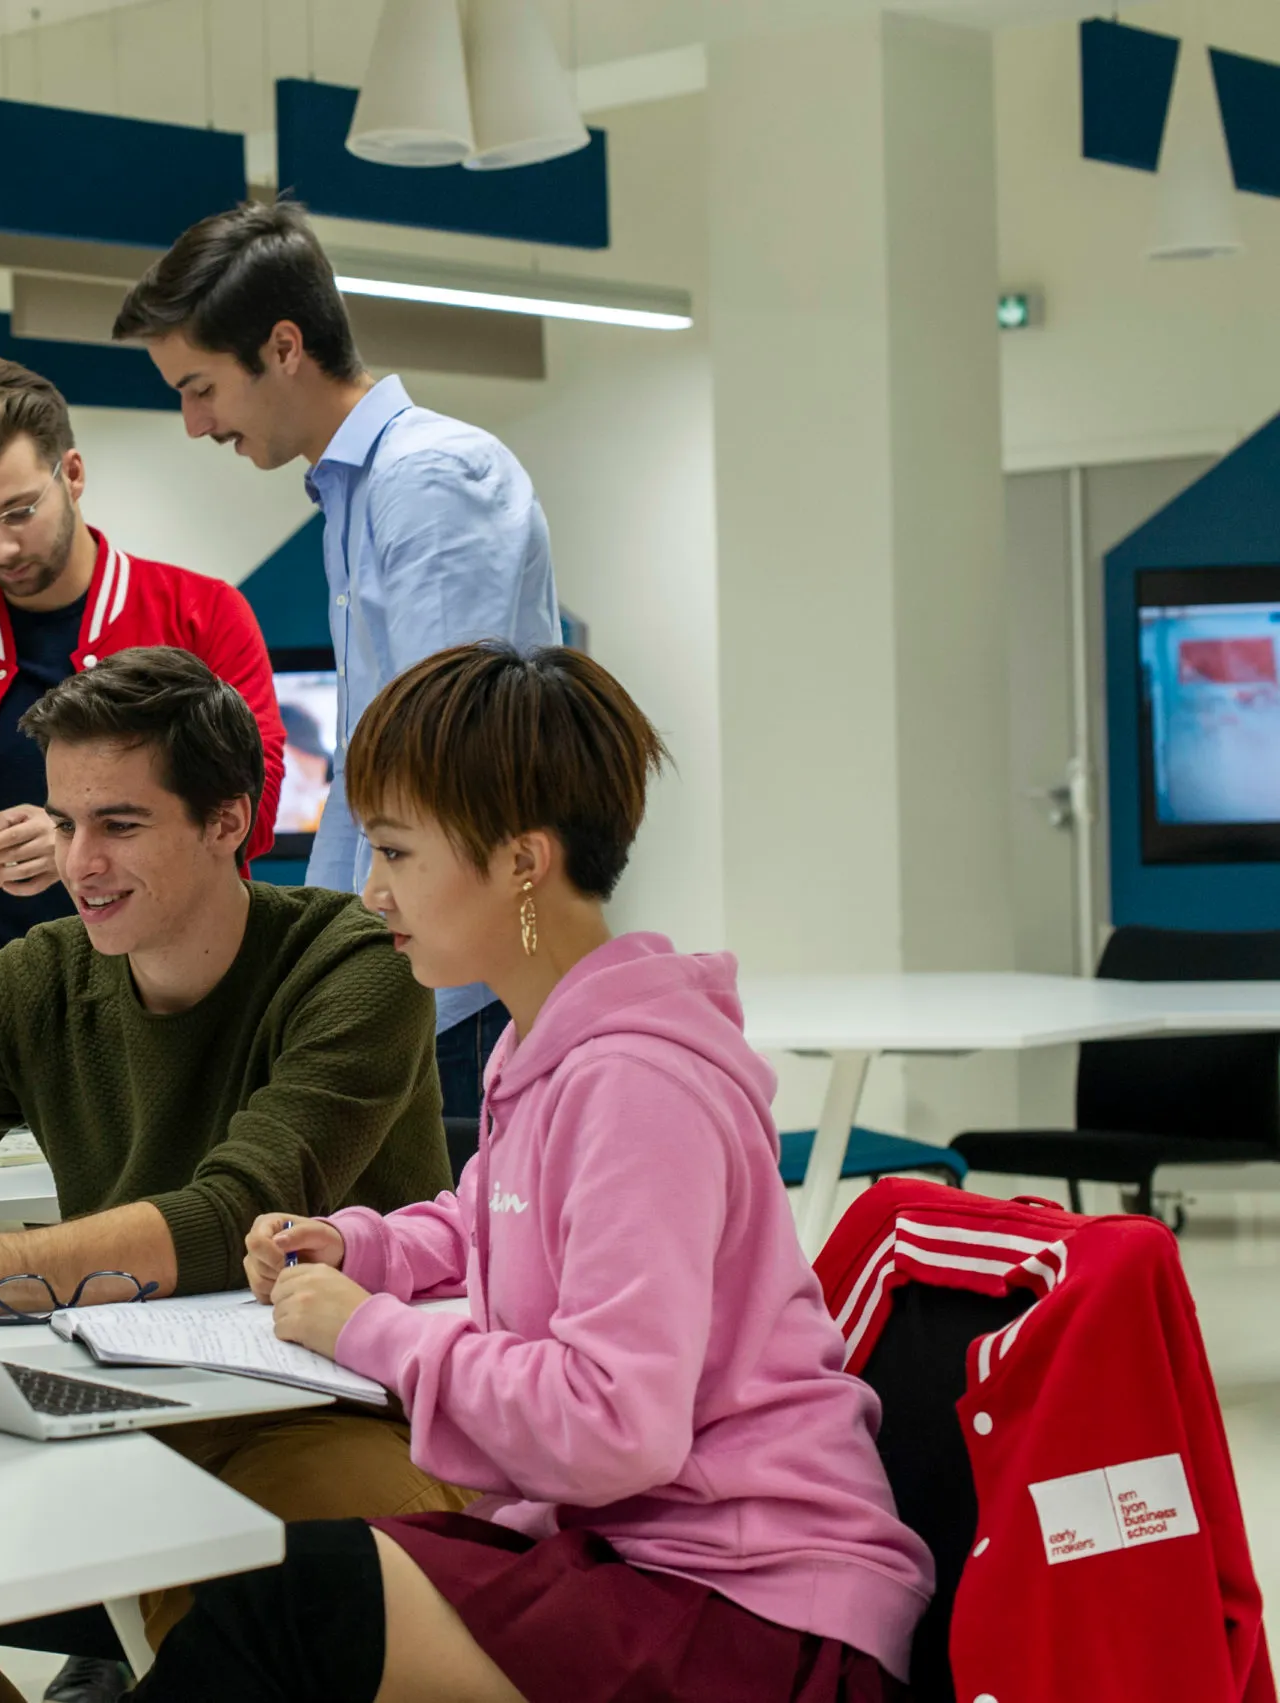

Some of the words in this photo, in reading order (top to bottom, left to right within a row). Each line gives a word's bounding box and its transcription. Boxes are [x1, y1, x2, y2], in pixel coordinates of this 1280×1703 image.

[1118, 1491, 1137, 1502] em
[1121, 1501, 1147, 1516] lyon
[1124, 1508, 1177, 1527] business
[1049, 1530, 1077, 1546] early
[1127, 1522, 1168, 1540] school
[1051, 1538, 1095, 1556] makers
